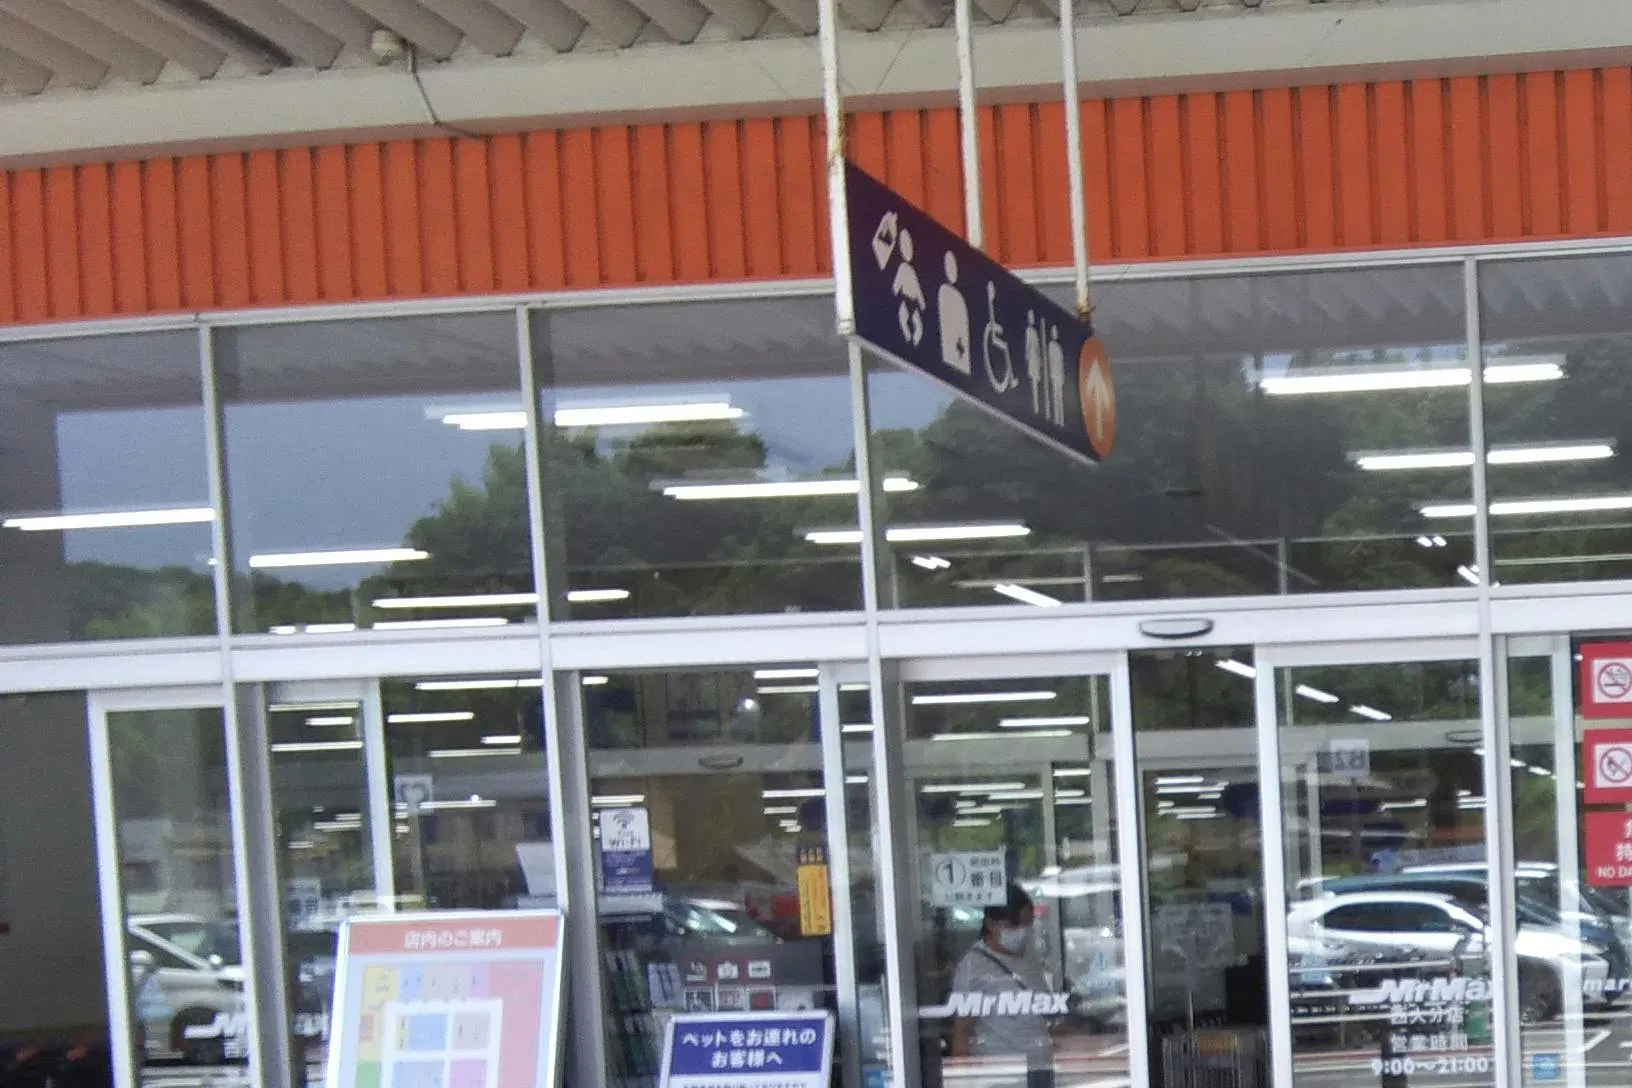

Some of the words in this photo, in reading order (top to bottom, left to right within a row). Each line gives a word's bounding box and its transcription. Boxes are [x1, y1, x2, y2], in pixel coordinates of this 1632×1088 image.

[1597, 866, 1616, 878] NO
[918, 991, 1071, 1018] MrMax
[682, 1027, 816, 1048] ペットをお連れの
[1390, 1033, 1468, 1053] 営業時間
[711, 1049, 783, 1069] お客様へ
